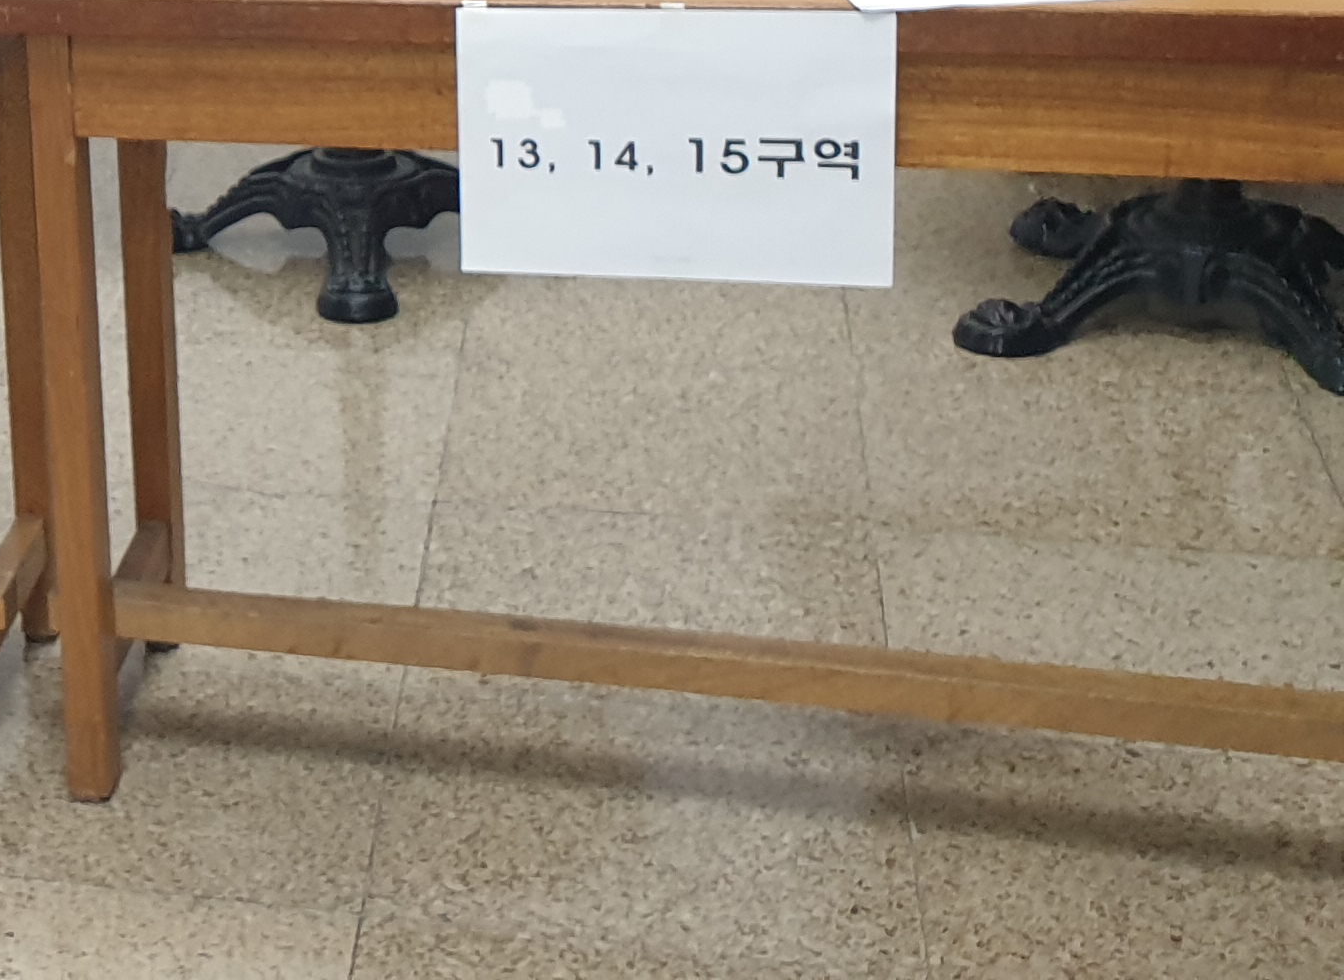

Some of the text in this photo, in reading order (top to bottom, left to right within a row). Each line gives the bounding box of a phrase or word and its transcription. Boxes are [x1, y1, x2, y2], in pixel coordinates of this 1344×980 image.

[490, 137, 860, 181] 13, 14, 15구역
